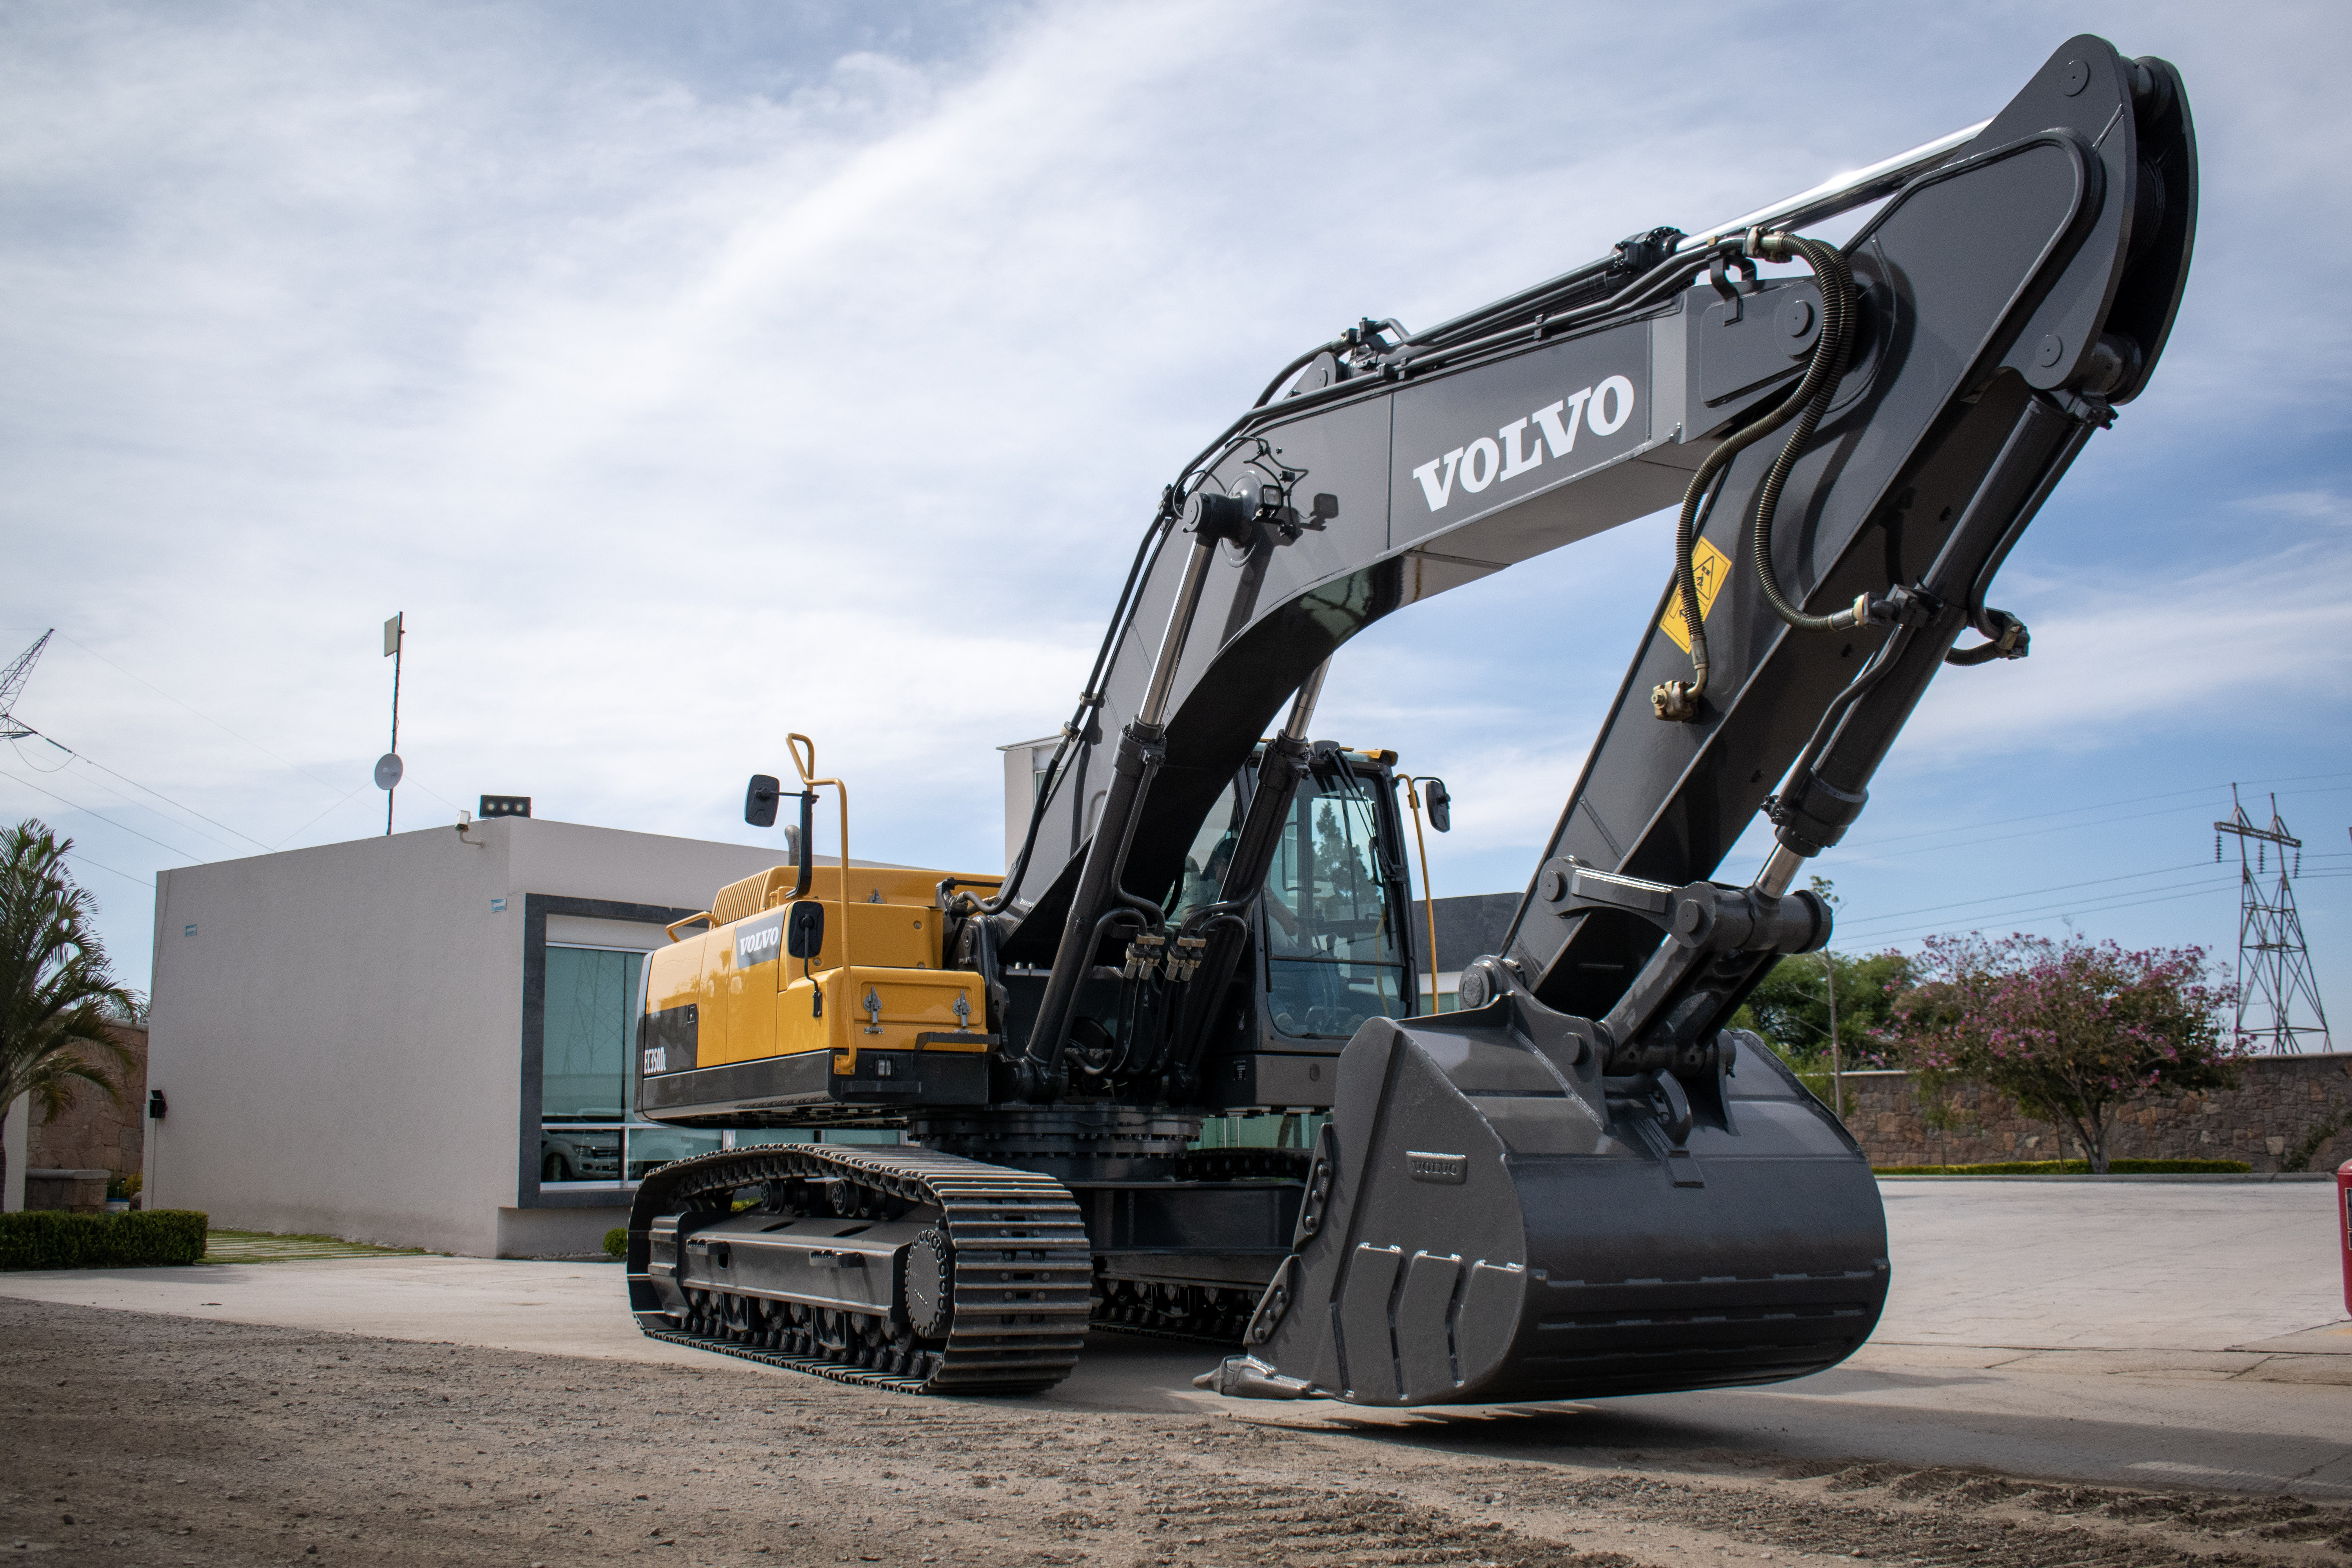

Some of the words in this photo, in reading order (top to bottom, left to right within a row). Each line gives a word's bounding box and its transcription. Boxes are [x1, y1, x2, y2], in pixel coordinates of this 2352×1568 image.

[1413, 375, 1634, 512] VOLVO
[740, 926, 779, 956] VOLVO
[1412, 1161, 1457, 1175] VOLVO
